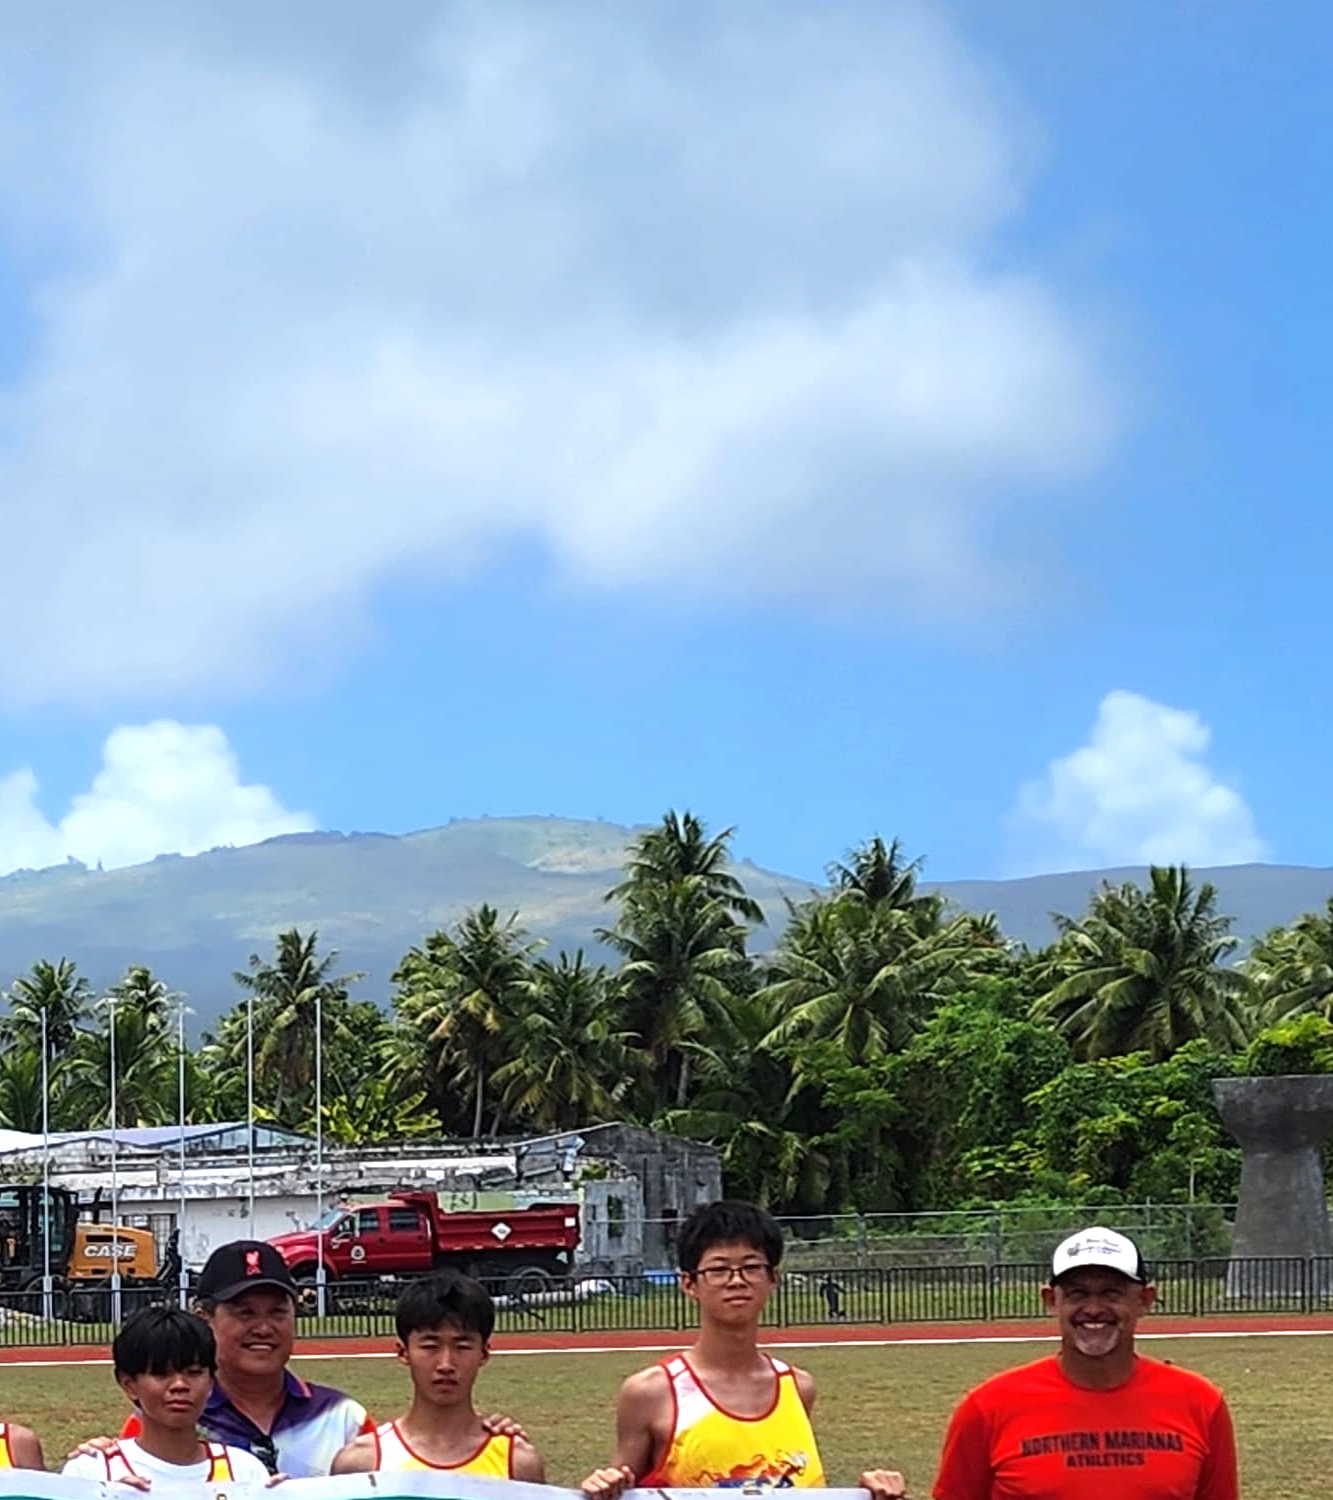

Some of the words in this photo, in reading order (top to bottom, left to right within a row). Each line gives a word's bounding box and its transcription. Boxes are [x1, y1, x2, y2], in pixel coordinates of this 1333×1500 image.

[83, 1244, 138, 1257] CASE
[1022, 1431, 1100, 1457] NORTHERN
[1104, 1430, 1184, 1452] MARIANAS
[1067, 1453, 1145, 1467] ATHLETICS
